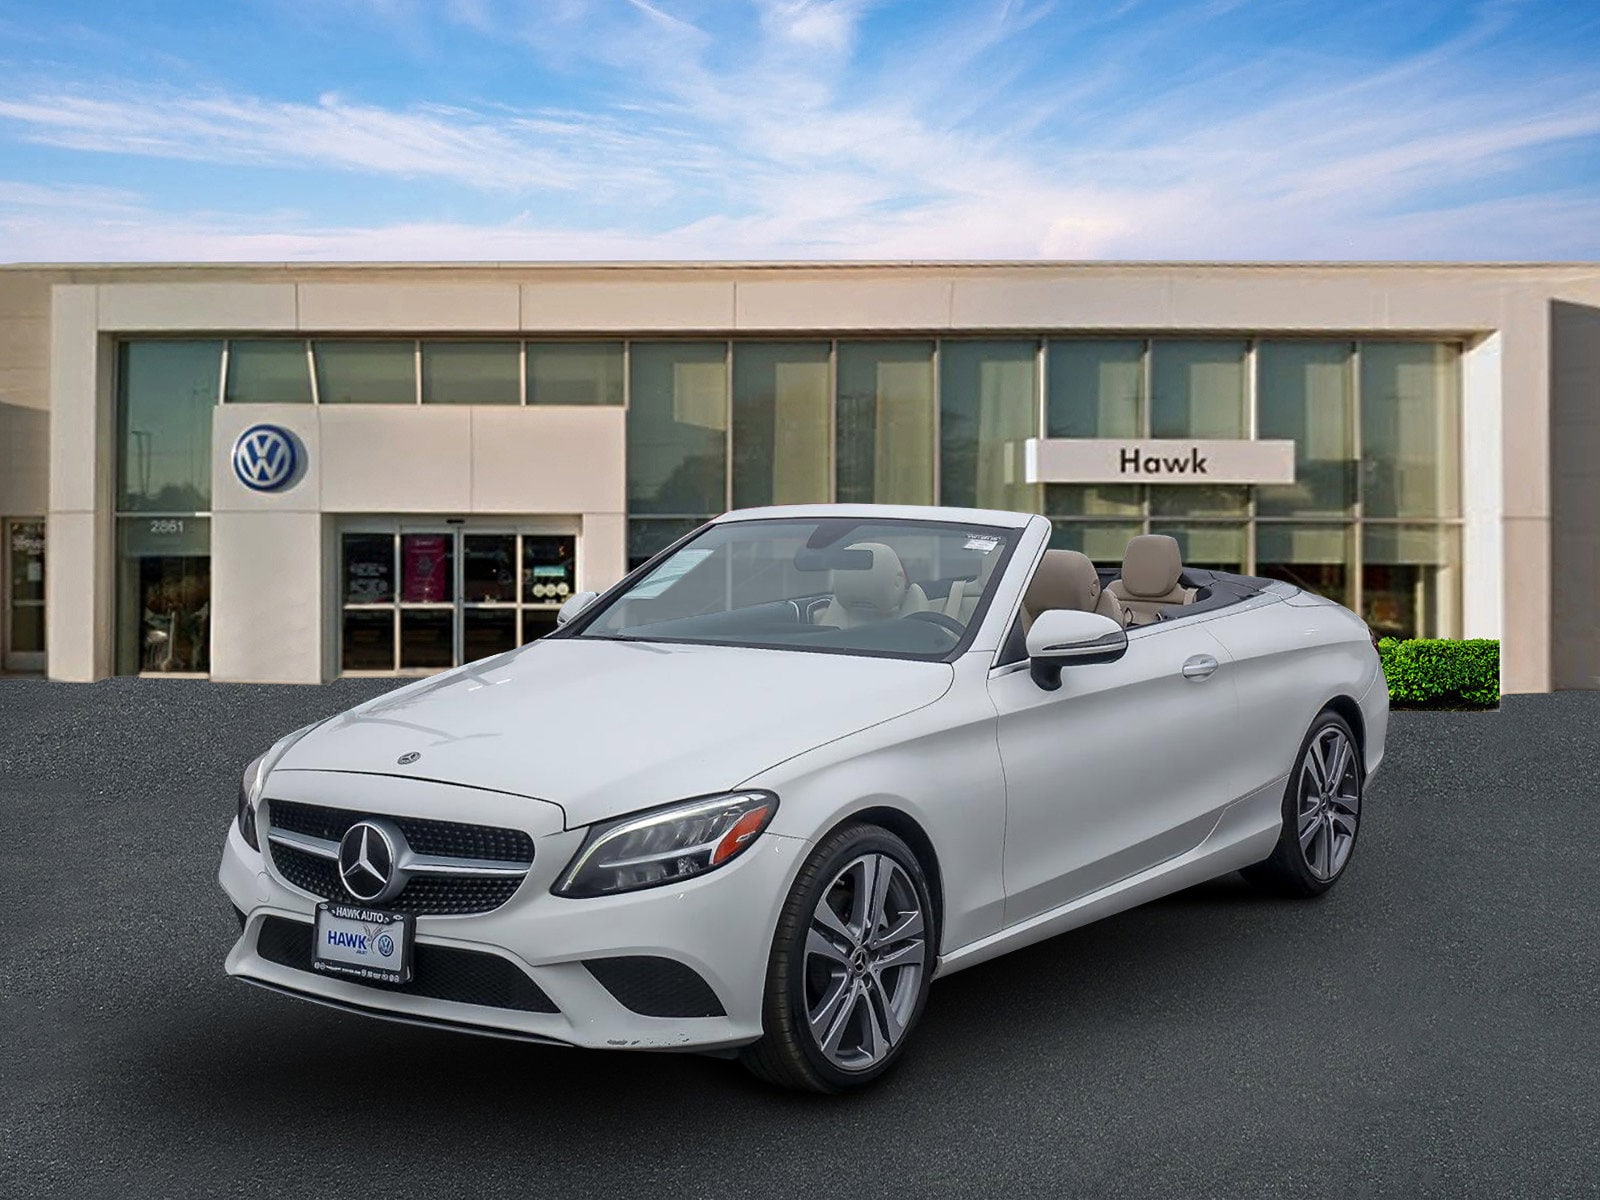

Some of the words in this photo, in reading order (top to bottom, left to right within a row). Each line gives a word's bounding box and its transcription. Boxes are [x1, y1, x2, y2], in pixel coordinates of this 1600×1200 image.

[1120, 447, 1207, 474] Hawk
[336, 906, 361, 920] HAWK
[361, 910, 384, 923] AUTO
[327, 930, 368, 950] HAWK
